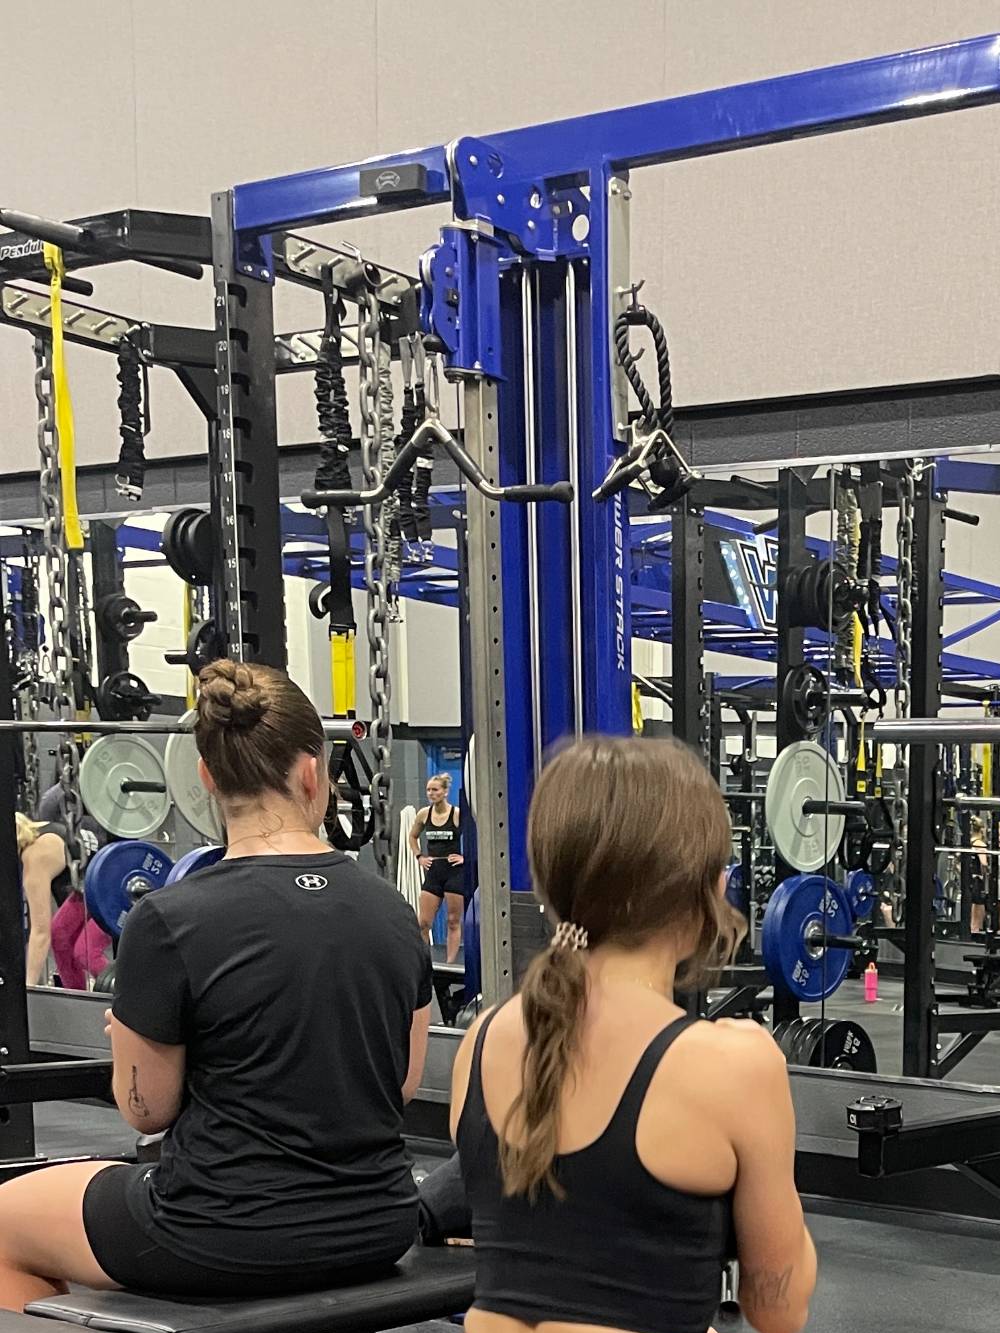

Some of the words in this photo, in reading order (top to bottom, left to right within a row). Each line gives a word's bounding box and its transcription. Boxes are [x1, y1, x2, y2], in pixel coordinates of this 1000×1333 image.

[0, 239, 45, 260] Pendul
[216, 296, 225, 306] 21
[218, 341, 227, 351] 20
[221, 384, 229, 395] 19
[224, 472, 232, 482] 17
[226, 515, 234, 526] 16
[228, 558, 236, 569] 15
[230, 601, 238, 611] 14
[615, 574, 625, 671] STACK
[231, 643, 240, 654] 13
